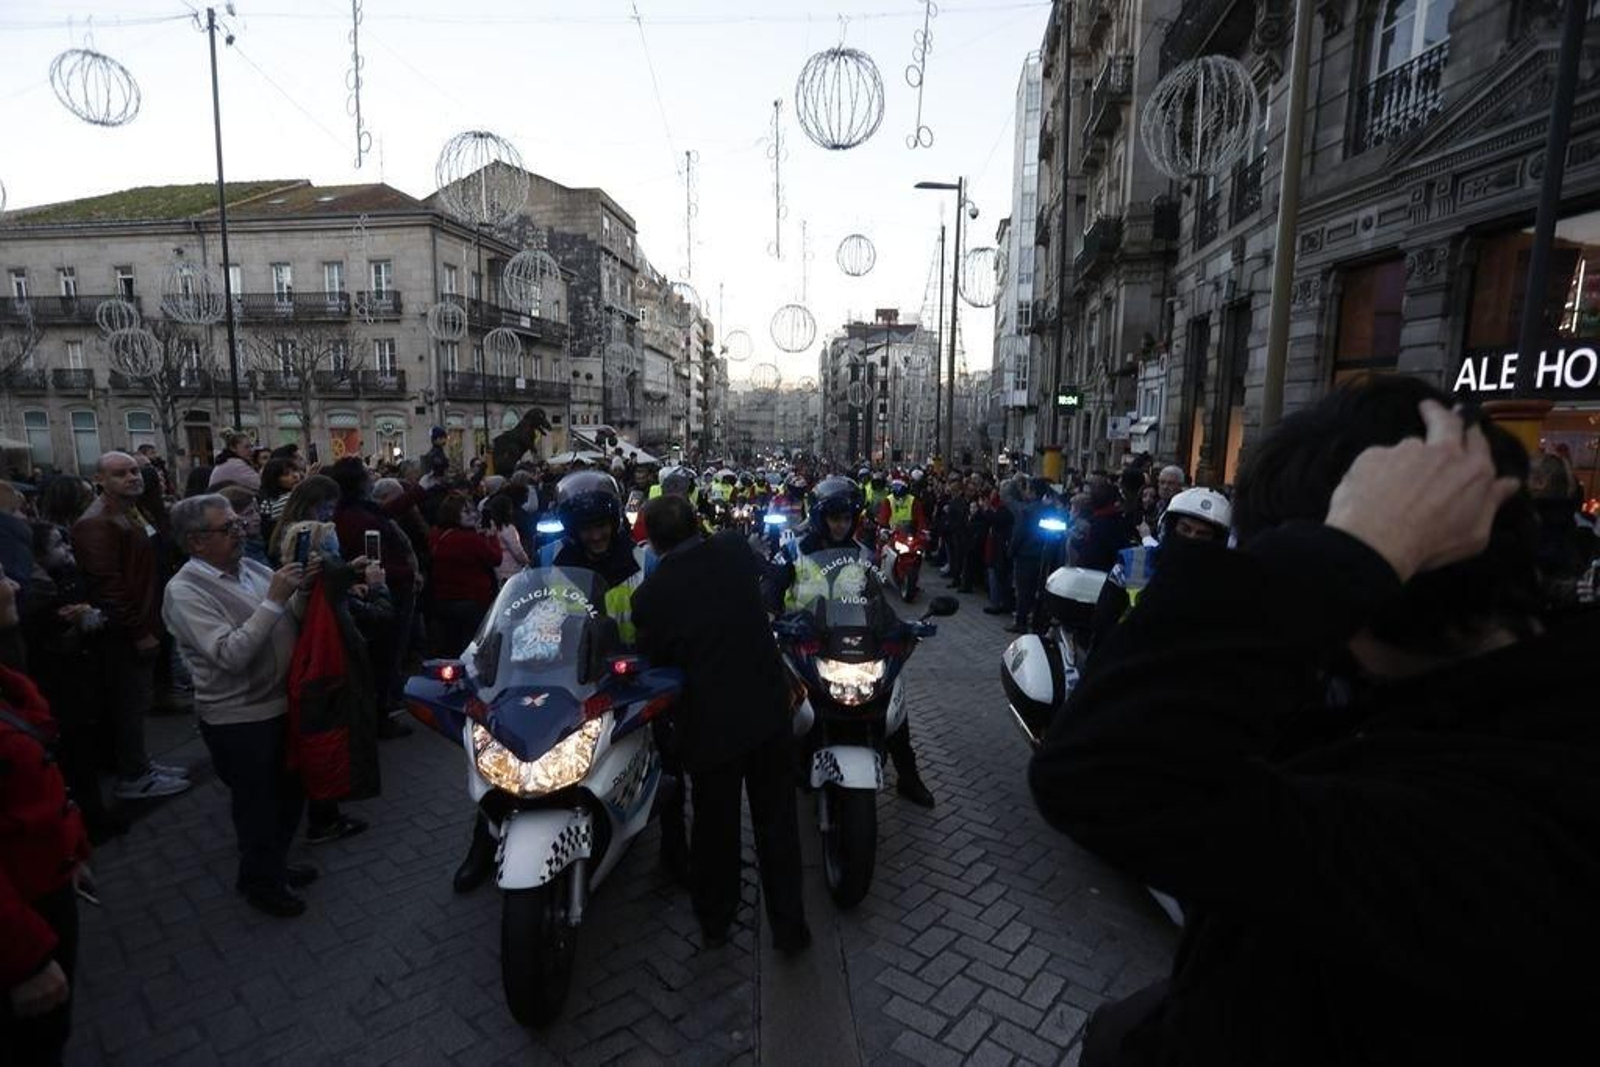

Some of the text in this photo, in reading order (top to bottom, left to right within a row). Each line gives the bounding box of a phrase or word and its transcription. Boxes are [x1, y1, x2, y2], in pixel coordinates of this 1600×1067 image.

[1453, 347, 1598, 392] ALE HO
[562, 588, 599, 619] LOCAL
[841, 596, 868, 605] VIGO
